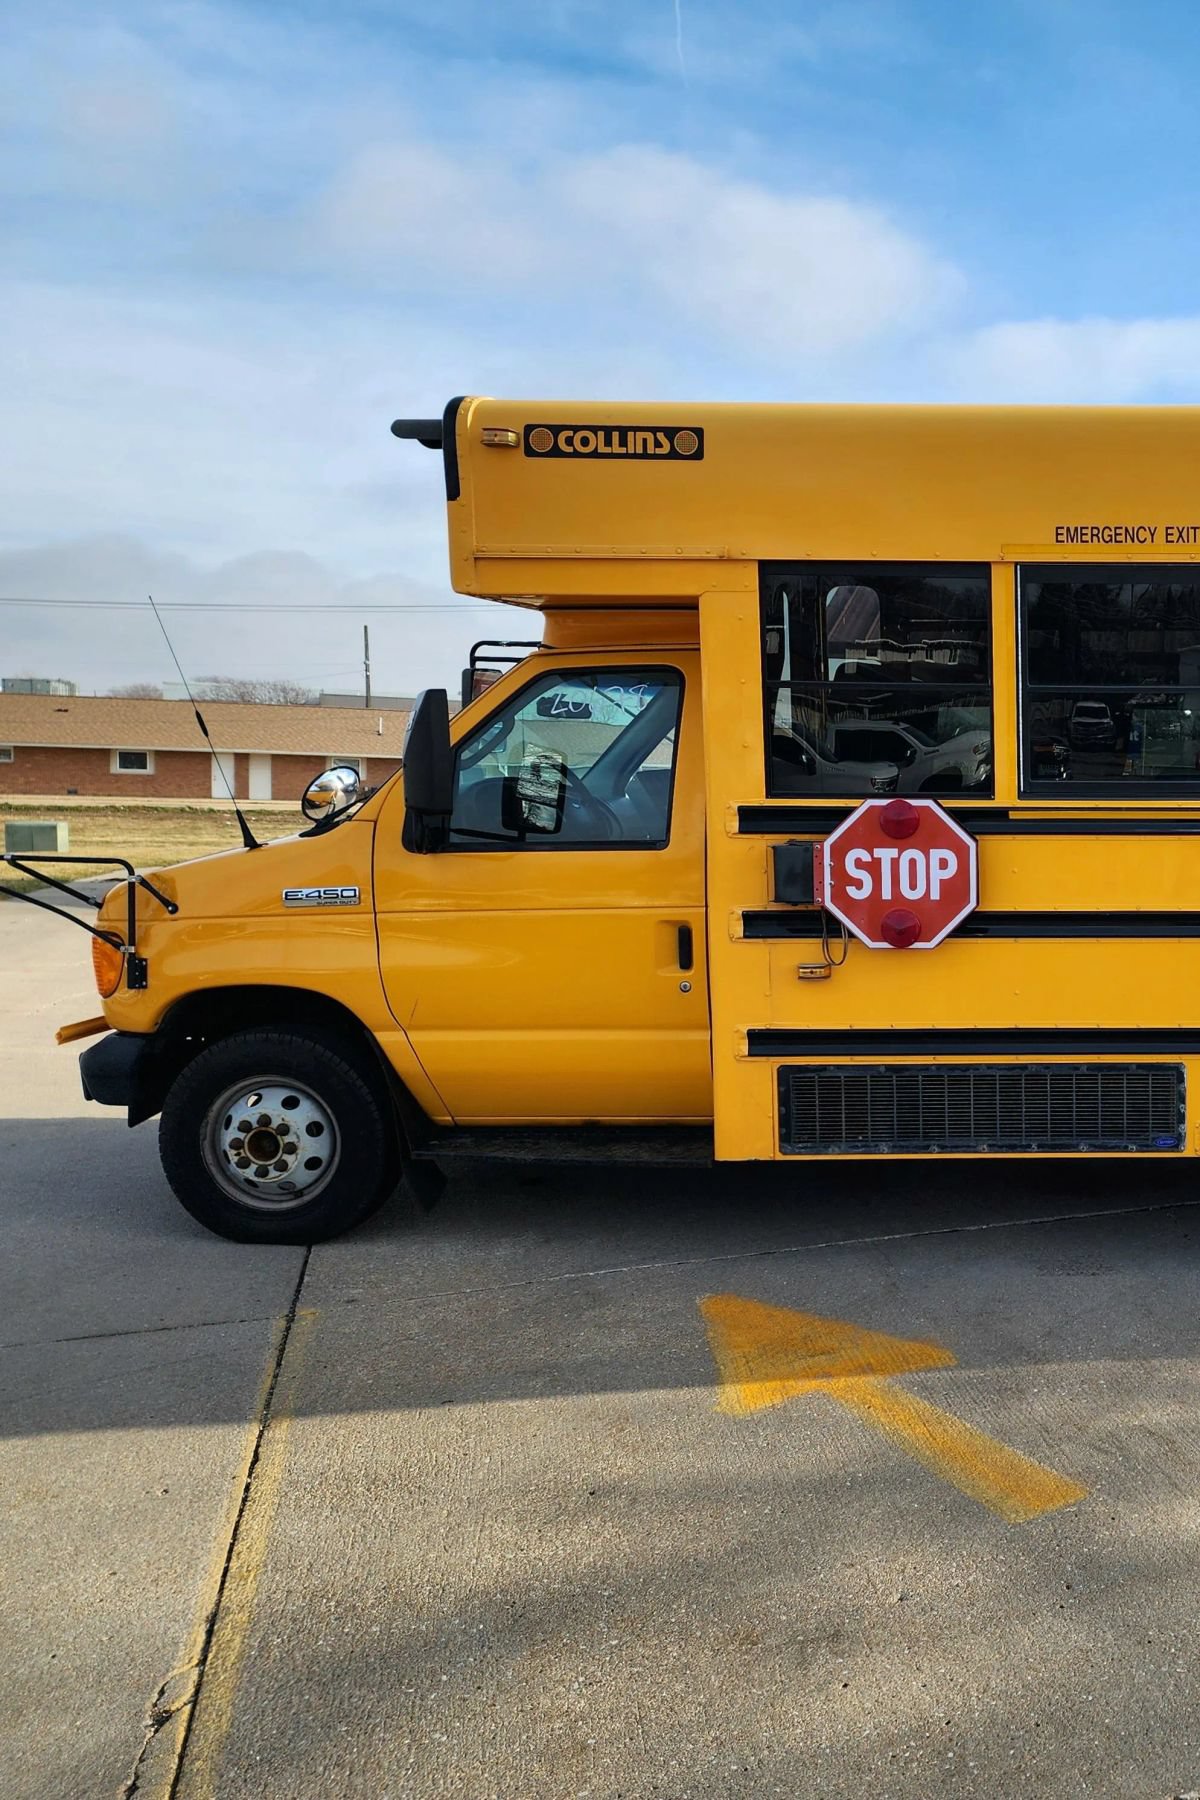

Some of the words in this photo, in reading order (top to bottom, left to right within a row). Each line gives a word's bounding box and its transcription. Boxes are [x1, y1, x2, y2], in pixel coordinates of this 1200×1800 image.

[557, 430, 671, 455] COLLINS
[1055, 526, 1157, 544] EMERGENCY
[1165, 526, 1200, 544] EXIT
[844, 848, 958, 900] STOP
